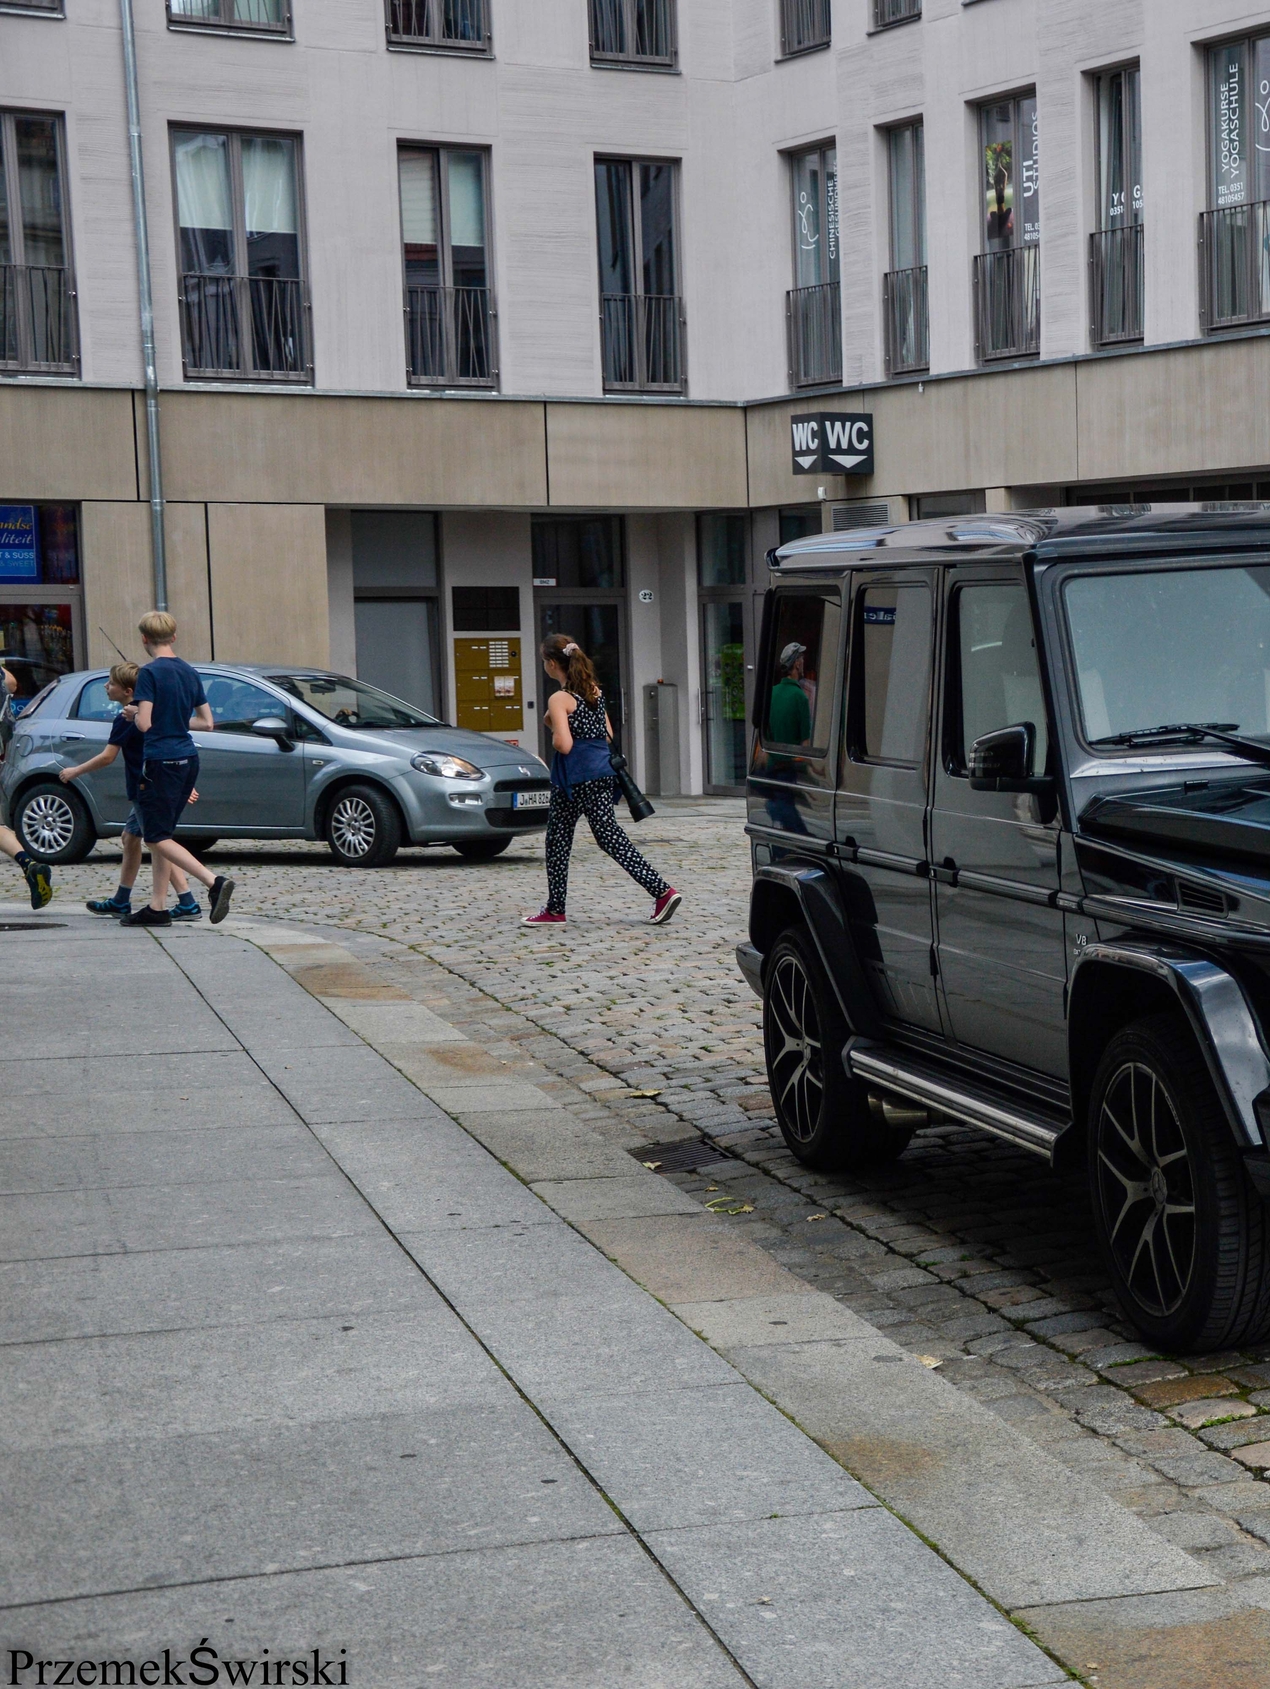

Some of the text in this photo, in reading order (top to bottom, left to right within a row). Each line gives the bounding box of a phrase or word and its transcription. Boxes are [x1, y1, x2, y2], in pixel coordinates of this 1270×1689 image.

[1221, 82, 1230, 172] YOGAKURSE
[1229, 62, 1240, 178] YOGASCHULE
[1022, 160, 1034, 197] UTI
[1218, 182, 1243, 195] TEL. 0351
[1218, 192, 1245, 204] 48105457
[827, 179, 836, 259] CHINESISCHE
[792, 421, 818, 451] WC
[825, 421, 869, 450] WC
[641, 591, 653, 600] 22
[1075, 933, 1087, 946] V8
